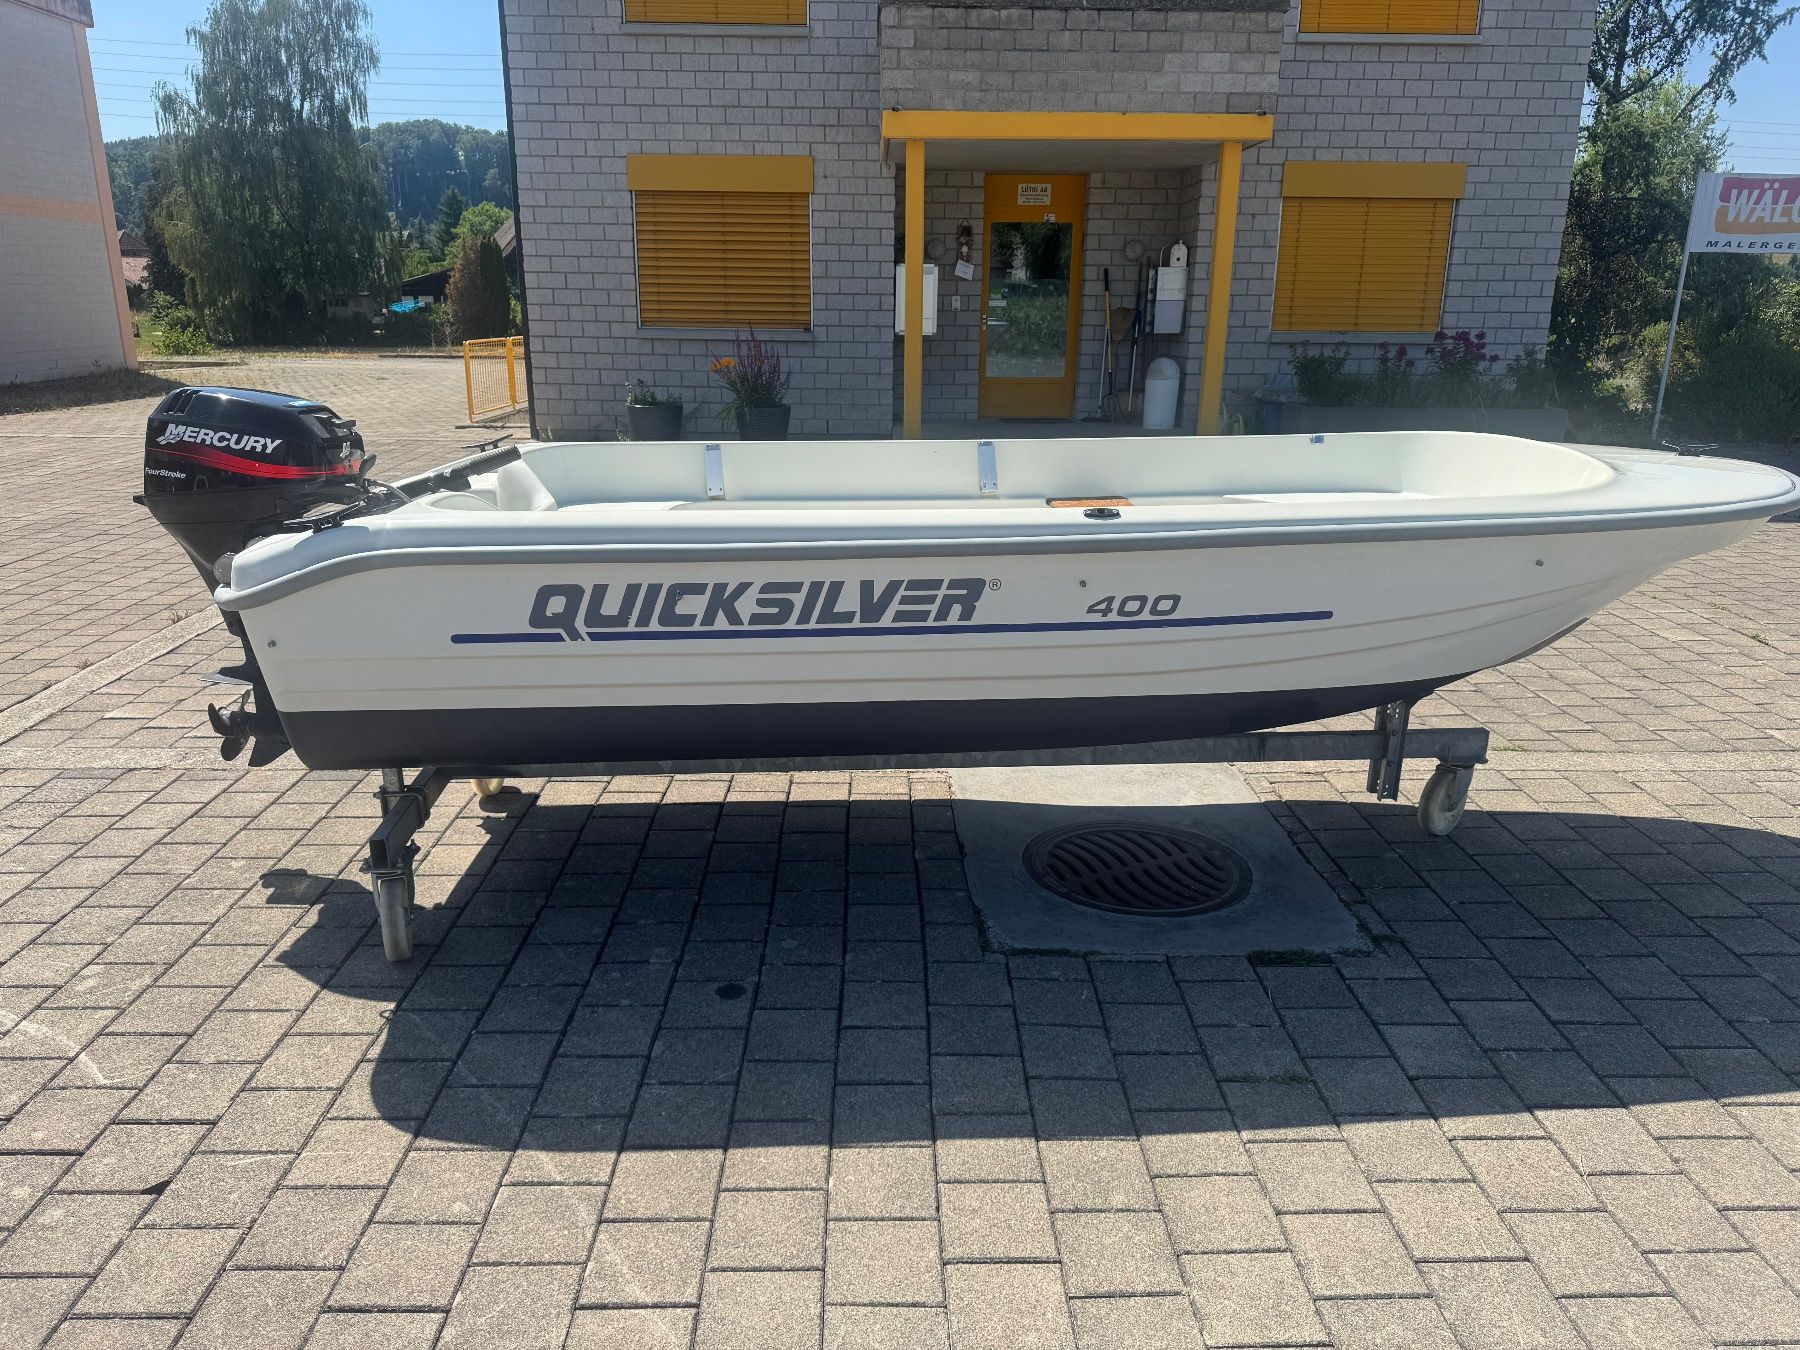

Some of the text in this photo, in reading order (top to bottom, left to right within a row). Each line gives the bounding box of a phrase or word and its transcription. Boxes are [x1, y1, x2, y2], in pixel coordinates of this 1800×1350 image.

[1705, 240, 1800, 250] MALERGE
[156, 422, 283, 454] MERCURY
[145, 467, 187, 479] FourStroke
[1086, 594, 1182, 618] 400
